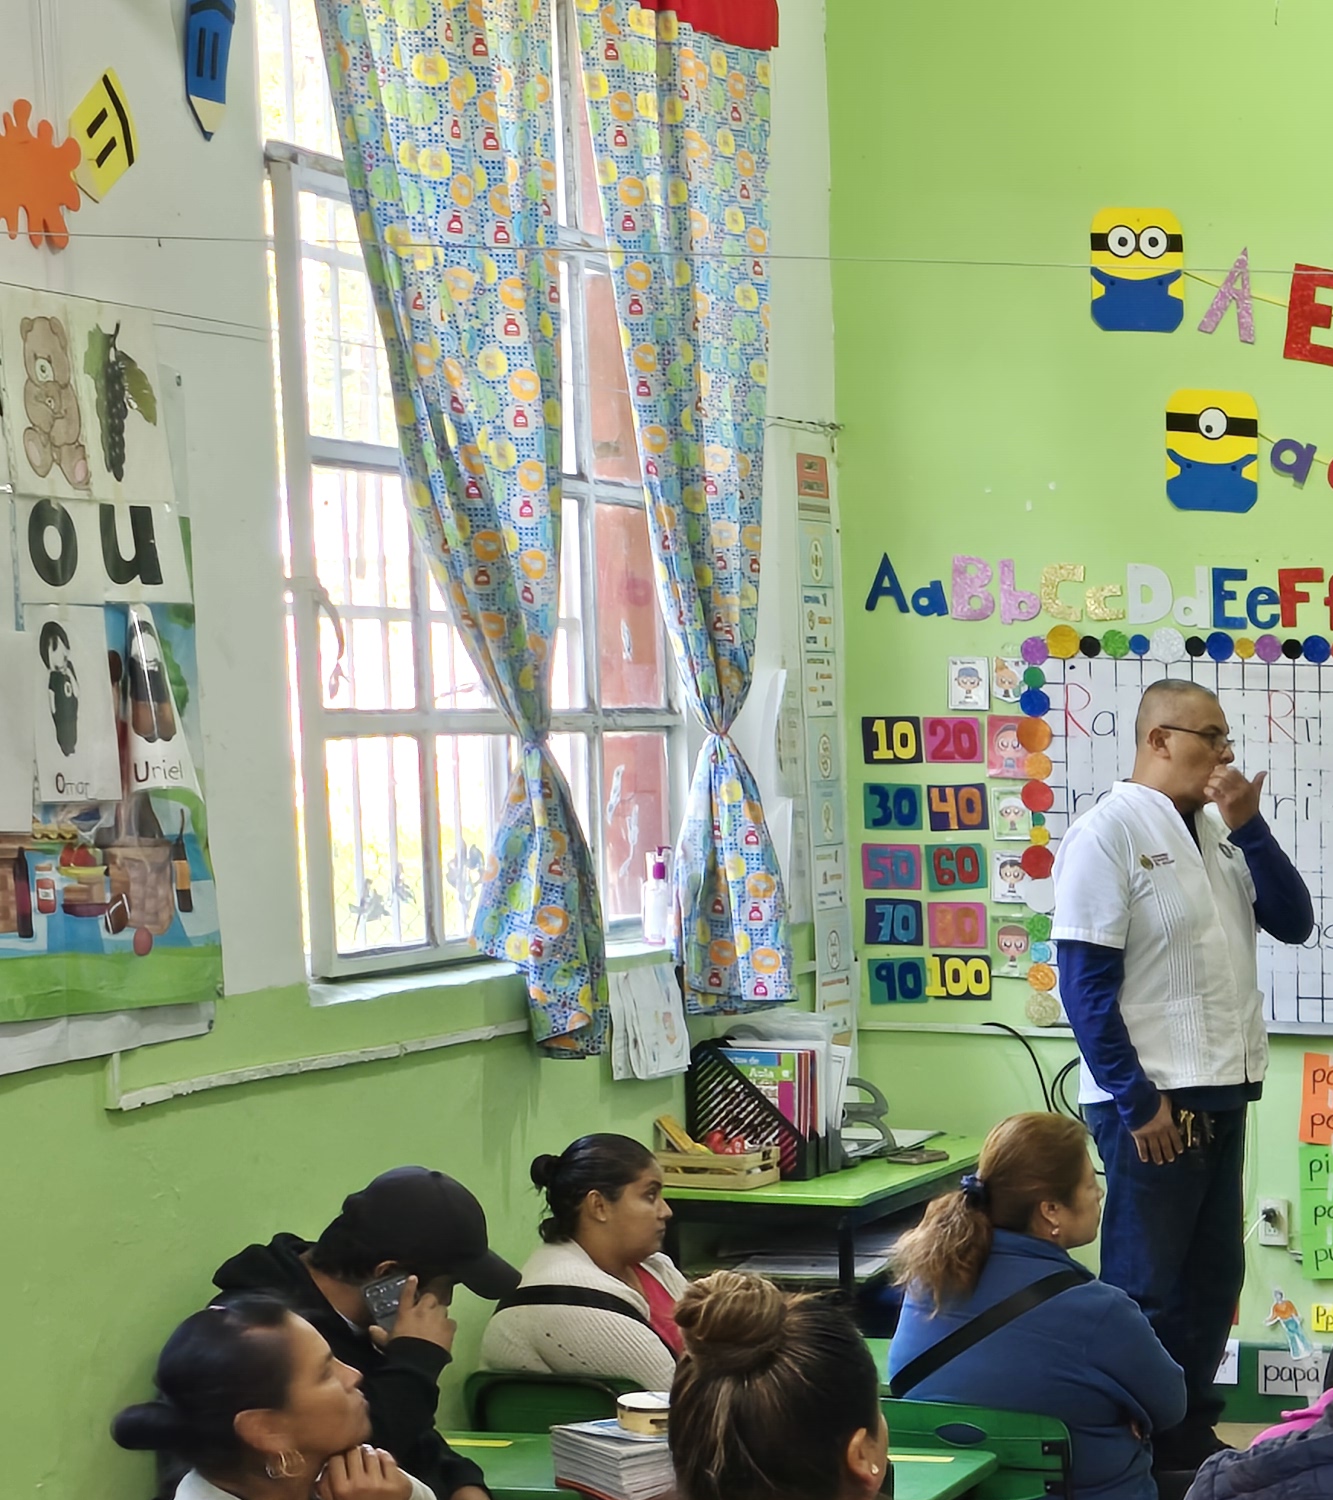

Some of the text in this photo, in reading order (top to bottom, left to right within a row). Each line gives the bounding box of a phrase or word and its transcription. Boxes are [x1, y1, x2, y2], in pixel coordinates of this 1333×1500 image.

[28, 498, 164, 587] o u
[1065, 683, 1116, 737] Ra
[872, 719, 976, 760] 10 20
[134, 760, 183, 783] Uriel
[869, 785, 982, 829] 30 40
[1274, 783, 1309, 820] ri
[868, 847, 980, 887] 50 60
[875, 904, 979, 945] 70 80
[875, 956, 990, 1000] 90 100
[1309, 1154, 1331, 1180] pi
[1264, 1360, 1320, 1392] papá
